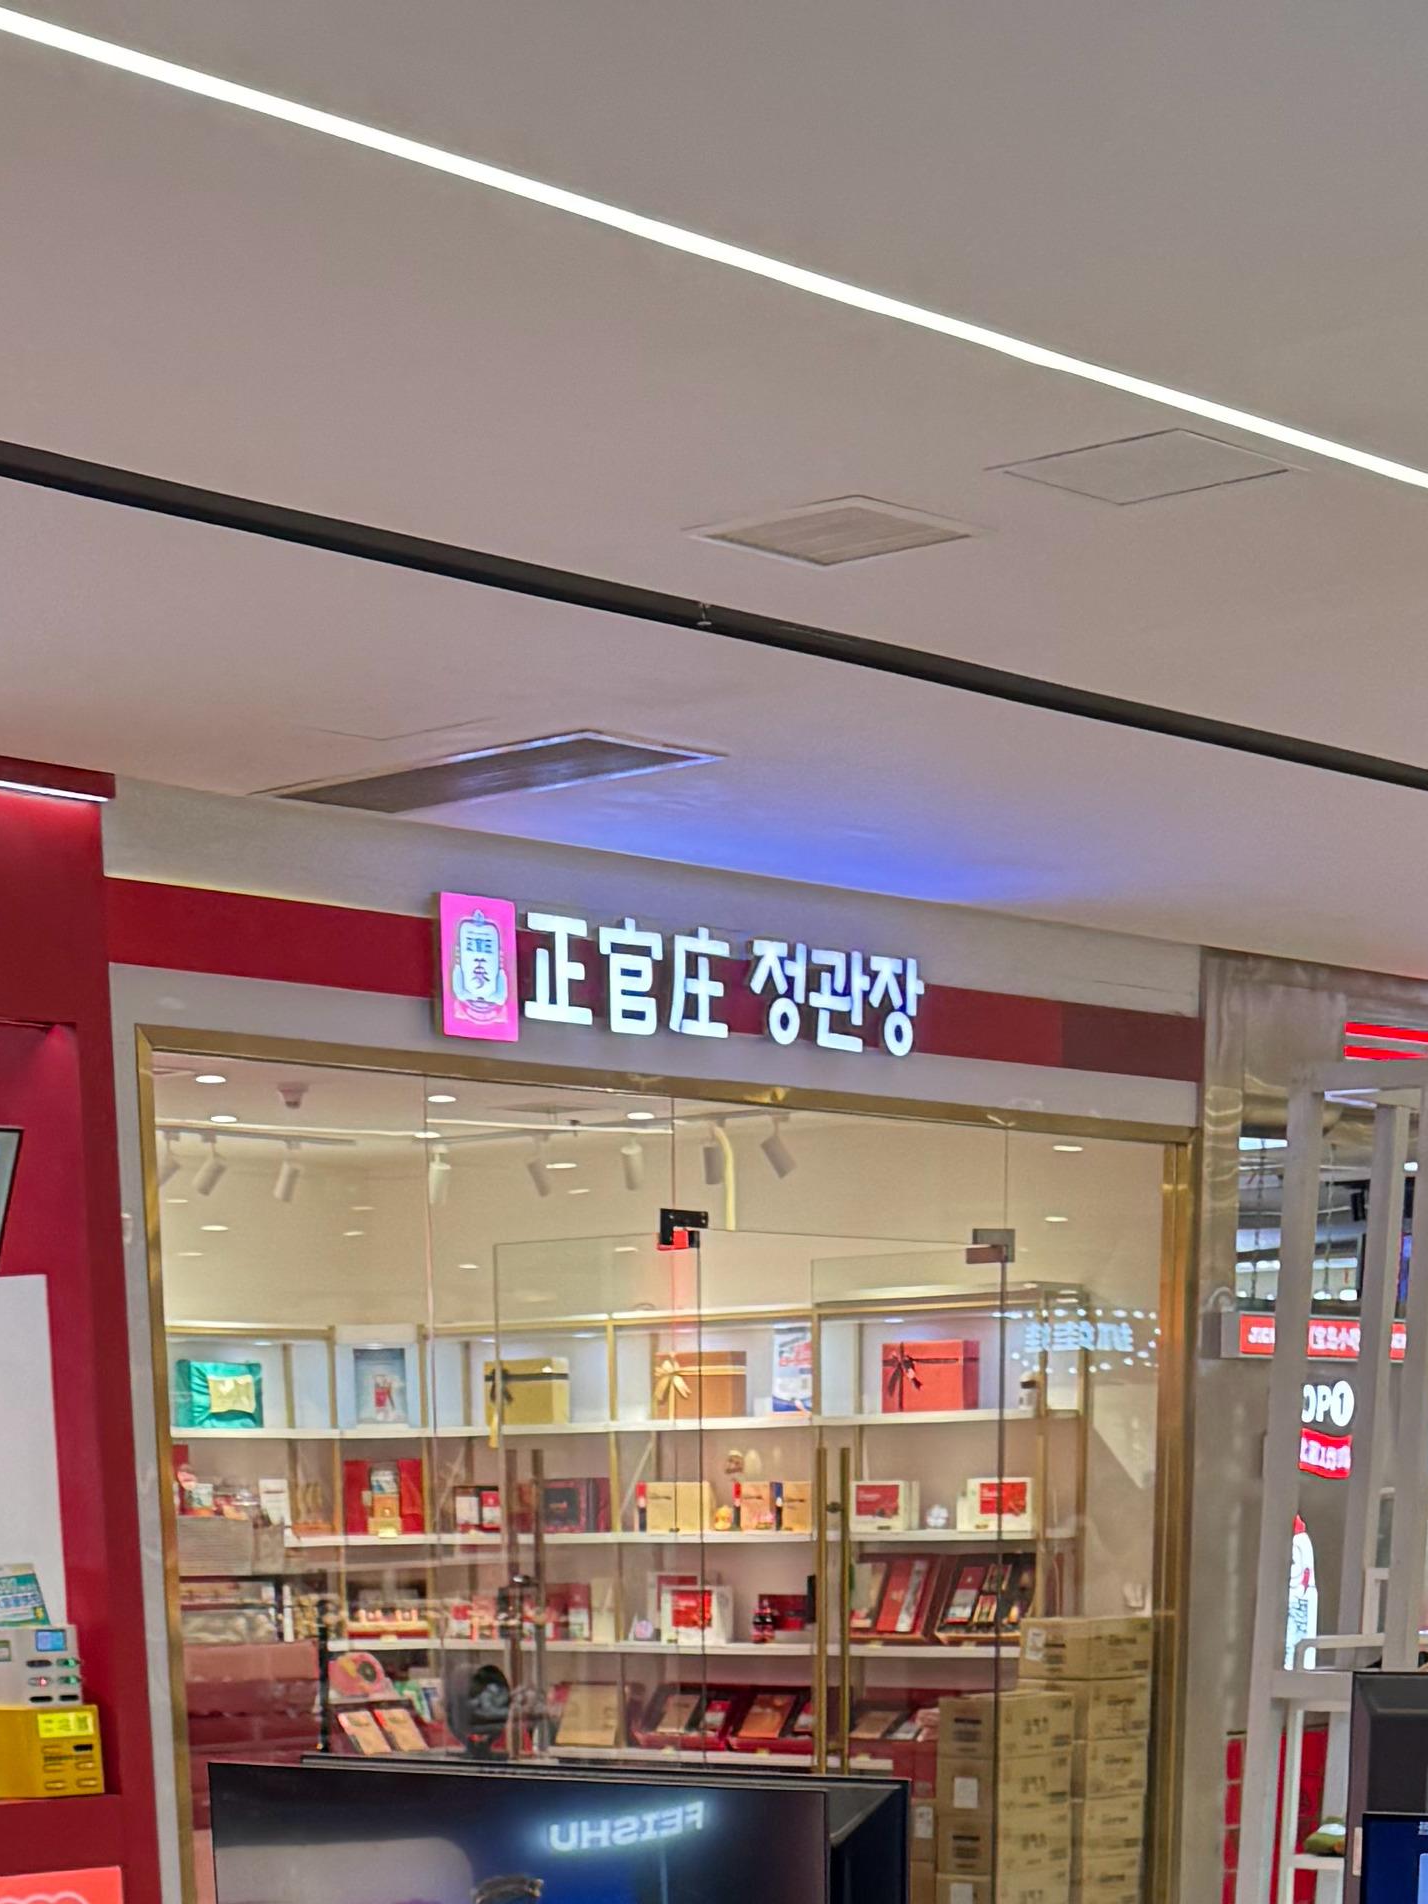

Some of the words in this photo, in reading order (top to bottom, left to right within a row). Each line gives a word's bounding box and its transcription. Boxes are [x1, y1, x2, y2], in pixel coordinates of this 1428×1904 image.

[524, 911, 731, 1039] 正官庄
[749, 938, 925, 1057] 정관장
